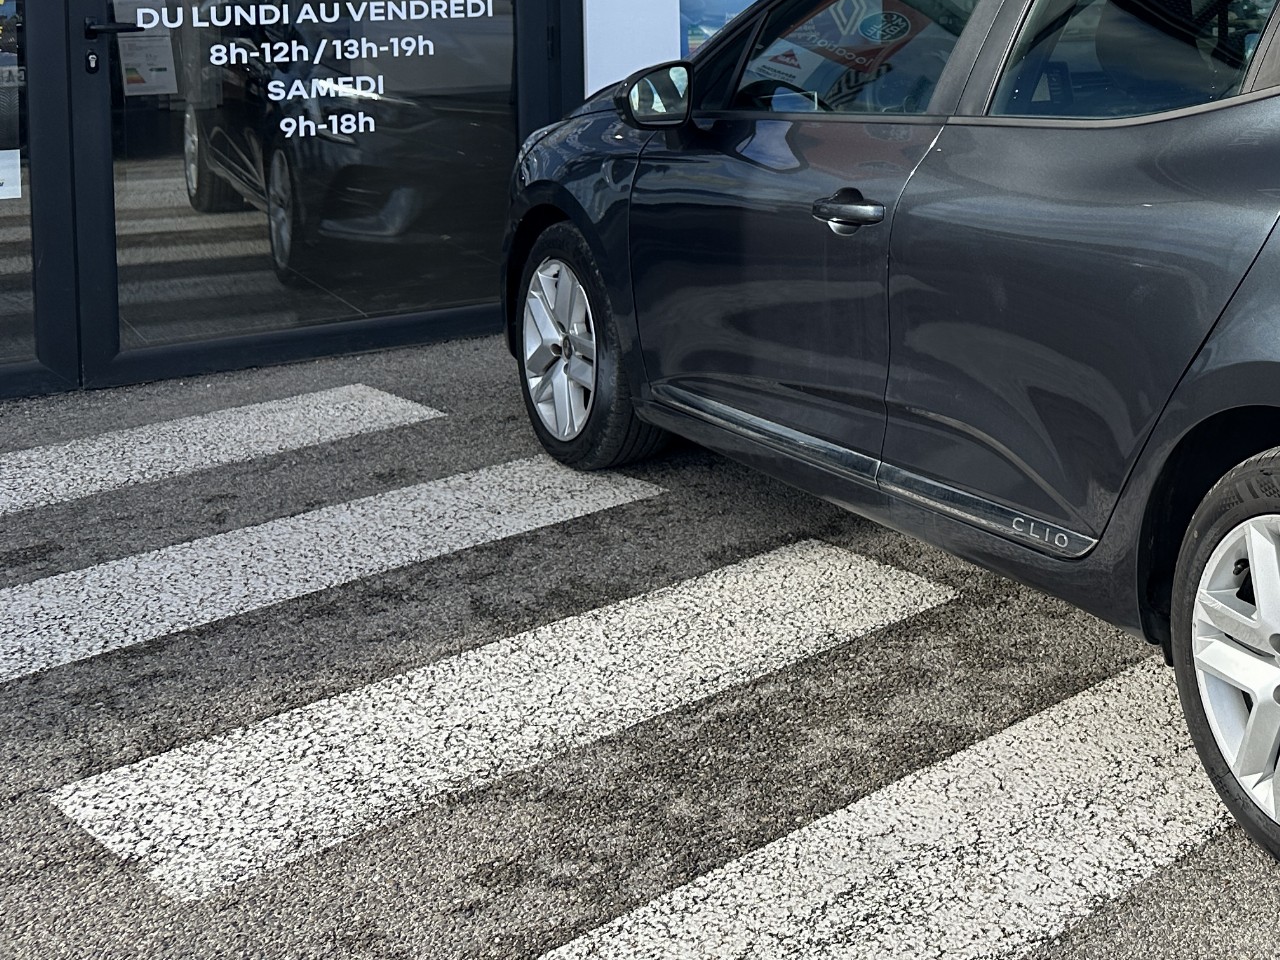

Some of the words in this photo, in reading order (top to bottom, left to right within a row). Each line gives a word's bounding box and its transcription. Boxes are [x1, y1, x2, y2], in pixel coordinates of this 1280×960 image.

[136, 6, 183, 29] DU
[192, 4, 289, 28] LUNDI
[296, 2, 340, 24] AU
[209, 40, 309, 66] 8h-12h
[313, 39, 328, 65] /
[331, 35, 434, 60] 13h-19h
[267, 75, 384, 101] SAMEDI
[279, 112, 376, 138] 9h-18h
[1013, 517, 1069, 548] CLIO
